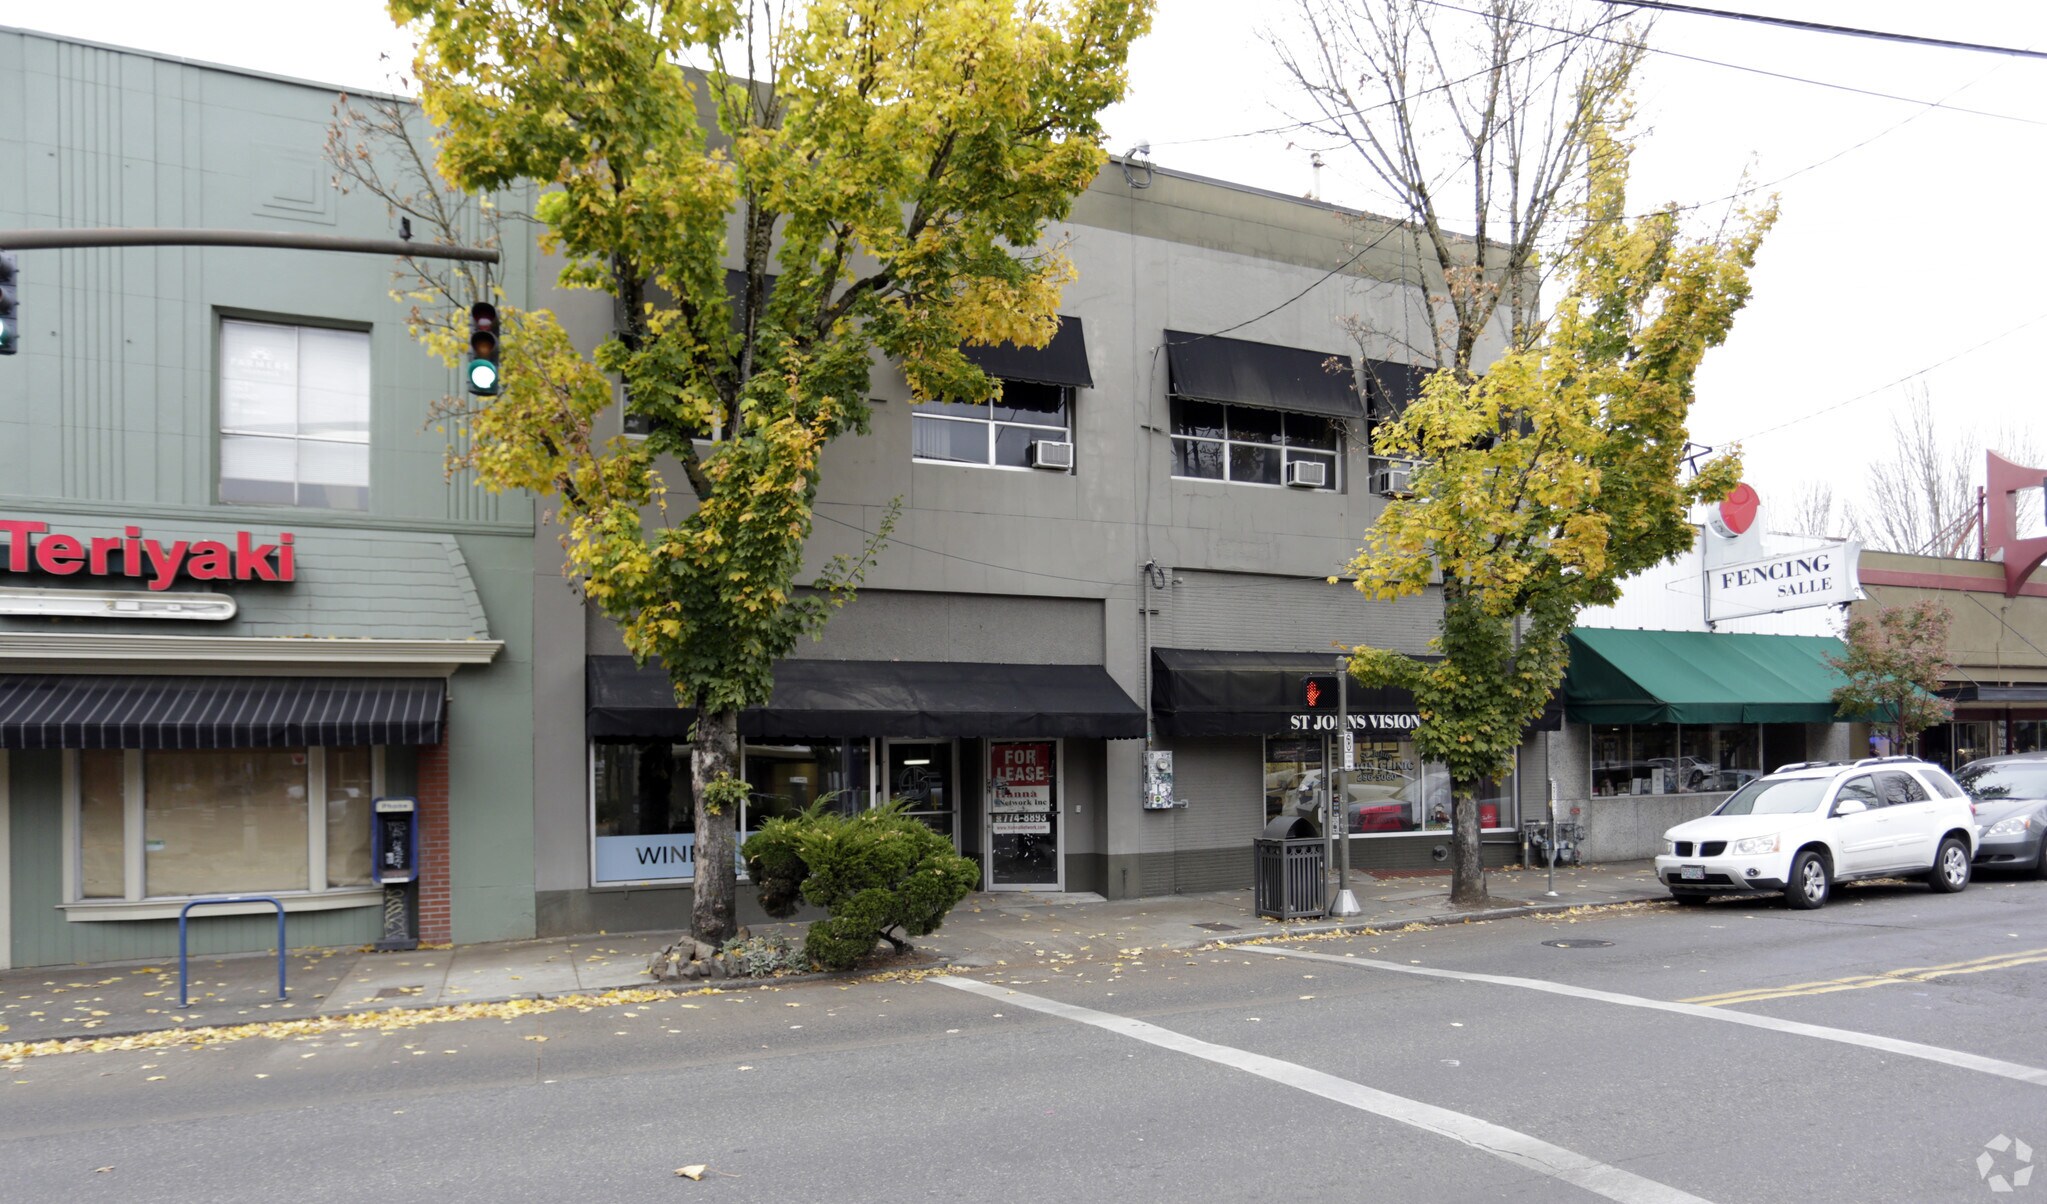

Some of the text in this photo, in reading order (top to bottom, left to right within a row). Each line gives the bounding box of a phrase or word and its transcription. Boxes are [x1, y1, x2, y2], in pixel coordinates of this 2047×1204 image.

[0, 519, 295, 590] Teriyaki
[1721, 555, 1830, 589] FENCING
[1777, 577, 1832, 598] SALLE
[1290, 714, 1421, 731] ST JONS VISION
[1004, 750, 1036, 765] FOR
[1379, 759, 1414, 771] CLINIC
[996, 766, 1044, 781] LEASE
